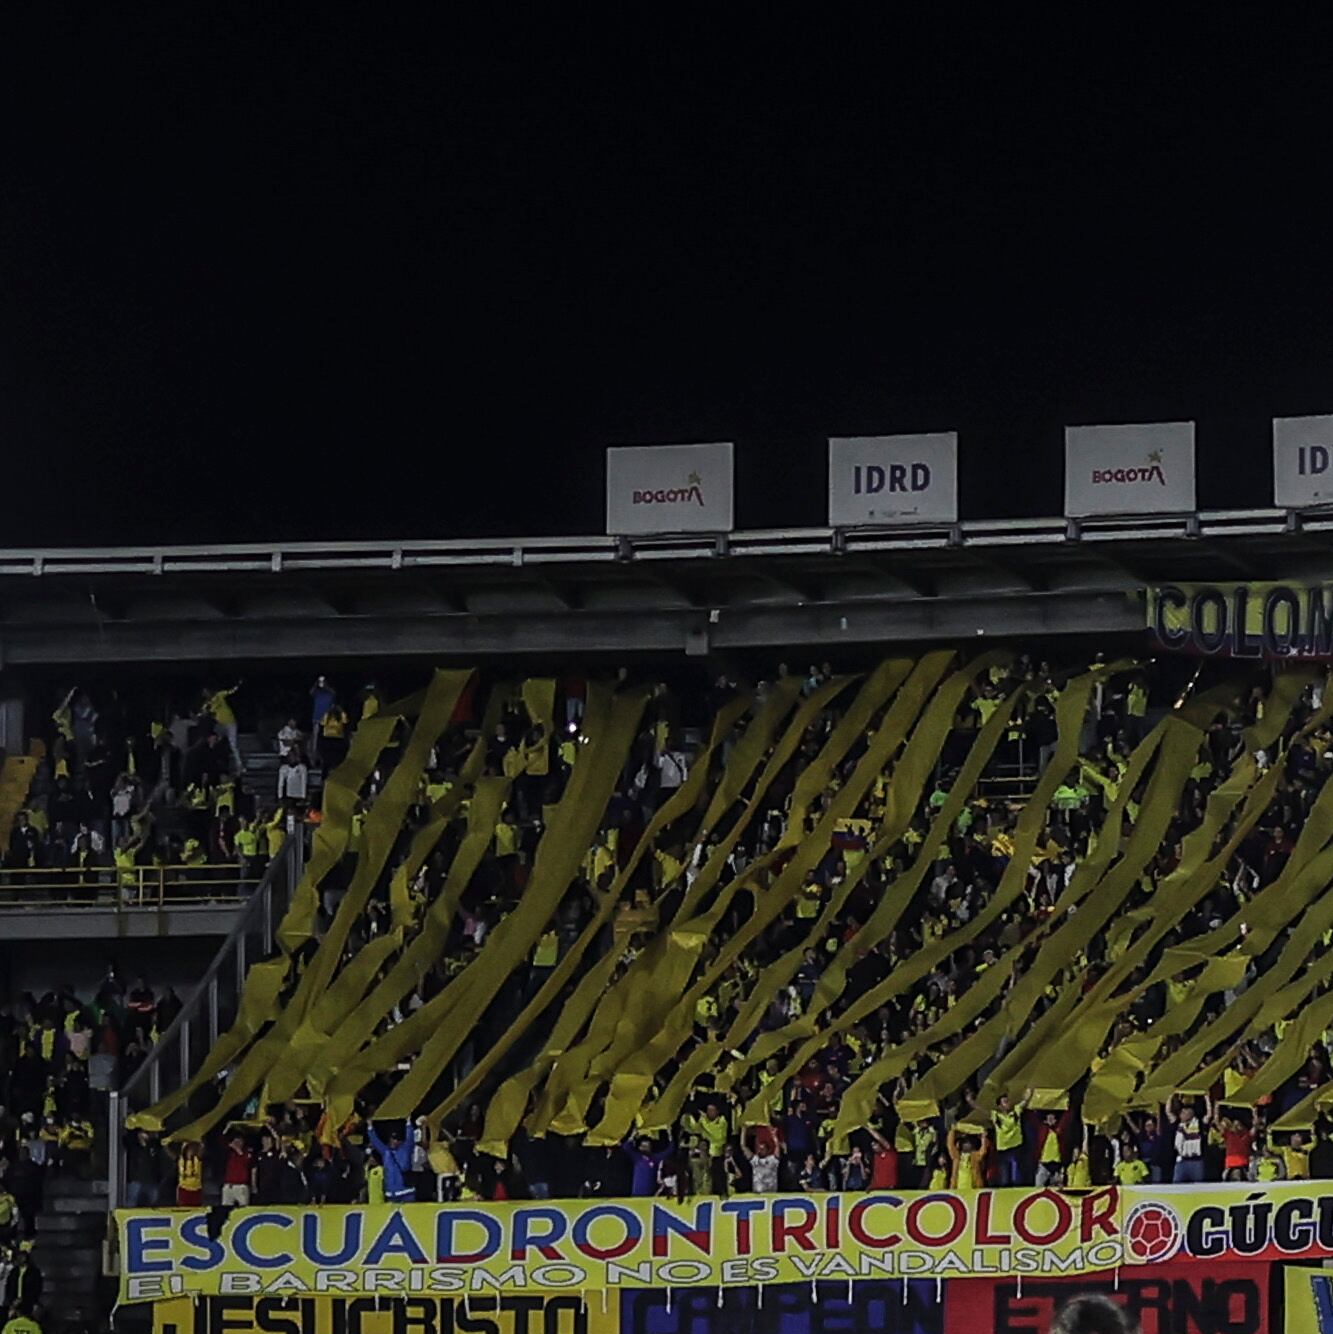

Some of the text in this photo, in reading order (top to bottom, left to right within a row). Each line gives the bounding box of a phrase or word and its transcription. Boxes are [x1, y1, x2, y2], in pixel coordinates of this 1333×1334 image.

[854, 463, 930, 494] IDRD
[219, 1261, 588, 1297] BARRISMO
[606, 1260, 714, 1285] NO
[720, 1257, 780, 1284] ES
[795, 1241, 1125, 1277] VANDALISMO
